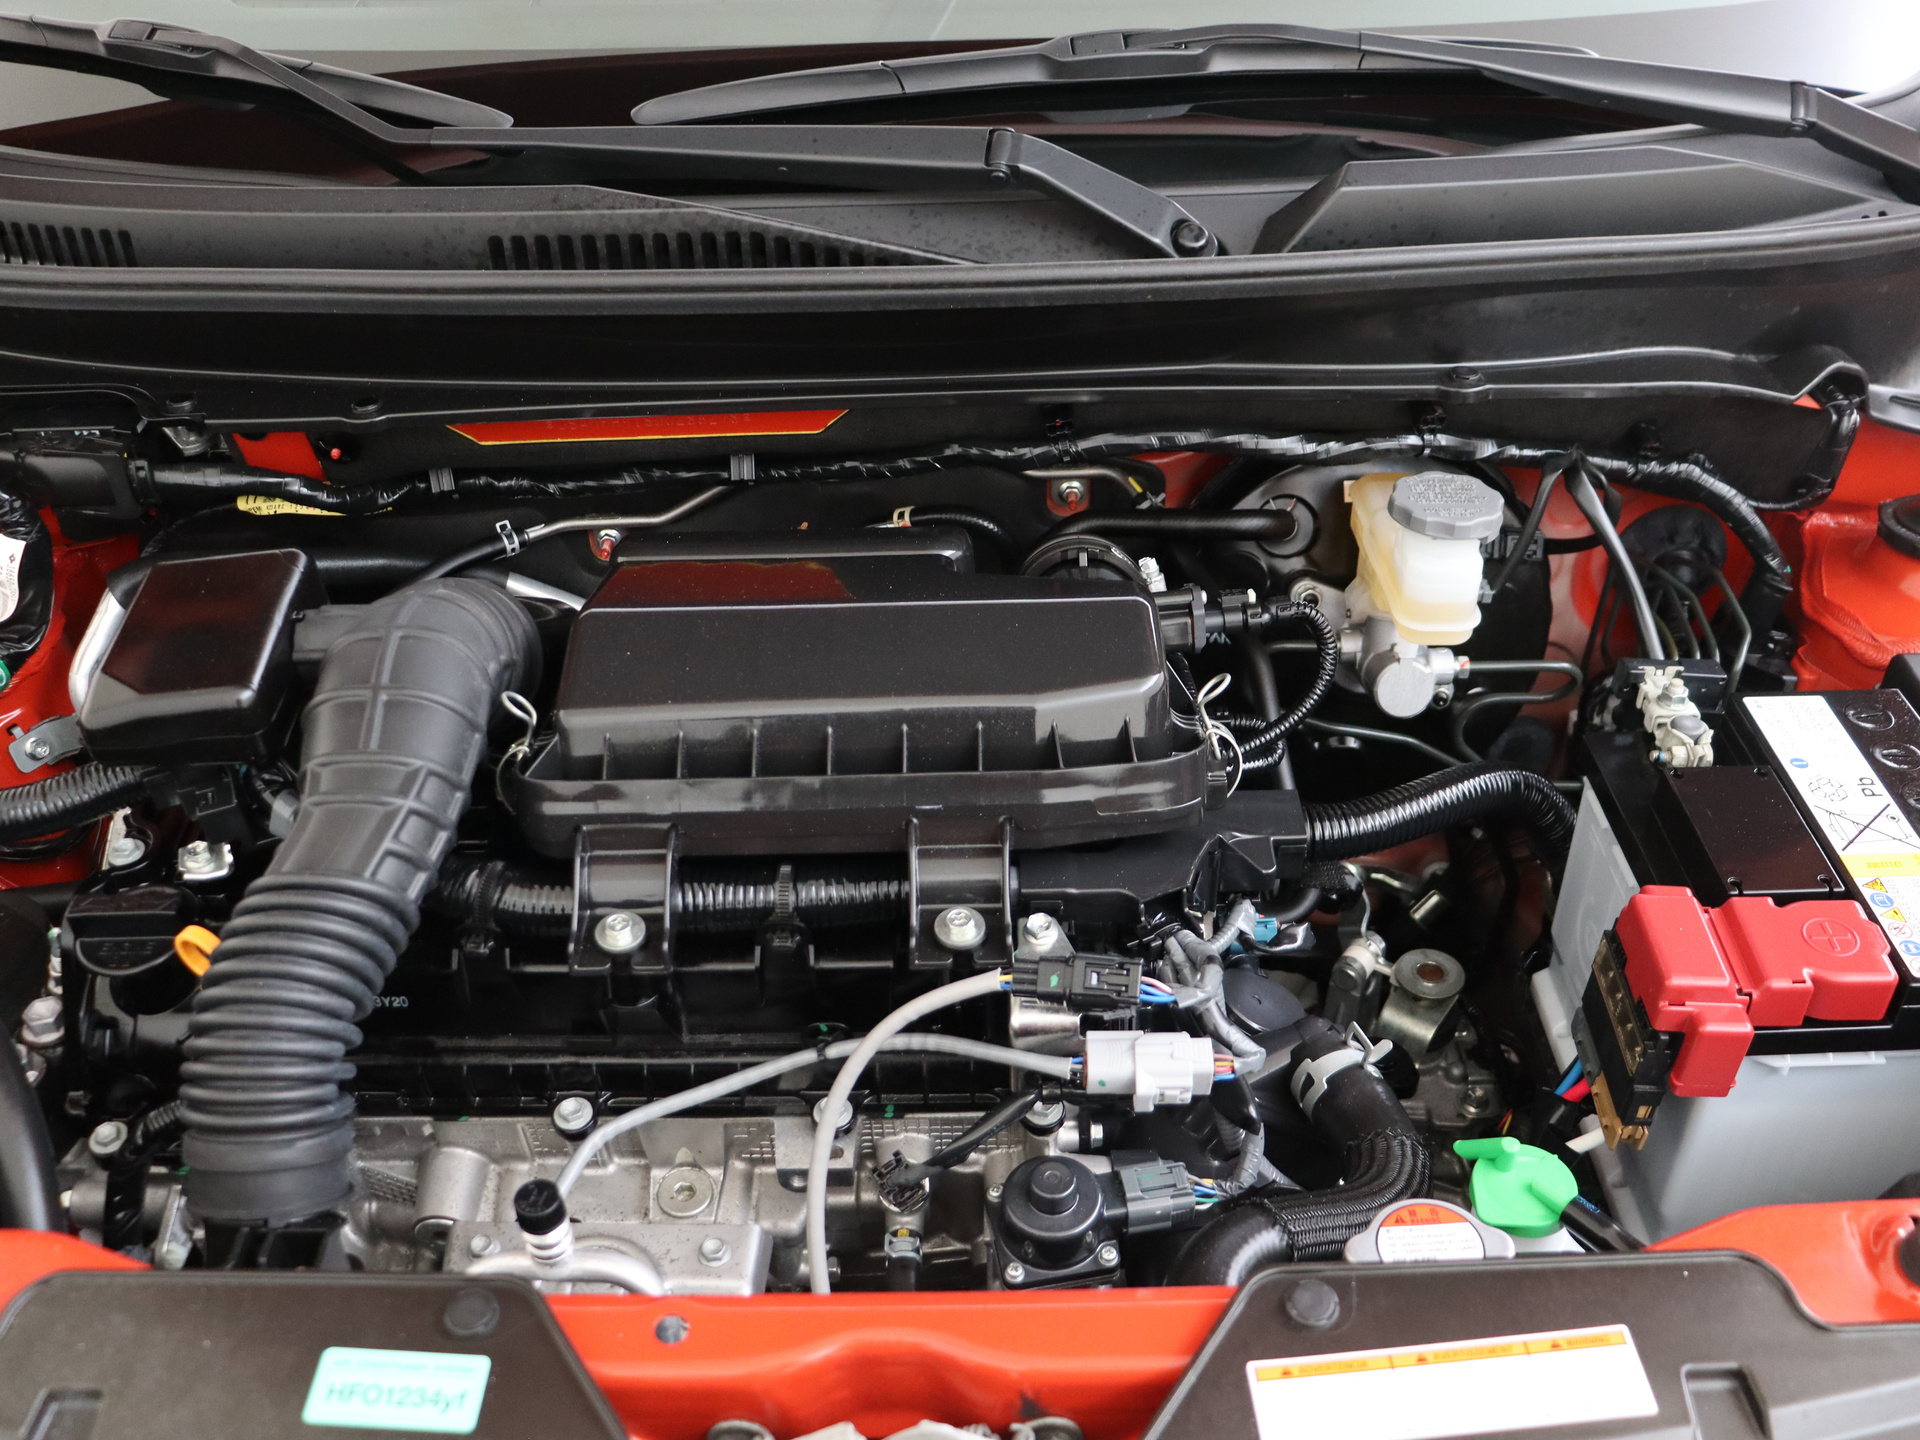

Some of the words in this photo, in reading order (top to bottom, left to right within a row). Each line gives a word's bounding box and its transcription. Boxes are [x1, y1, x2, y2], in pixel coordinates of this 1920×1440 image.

[1856, 776, 1884, 798] Pb
[1410, 1216, 1442, 1224] WARNING
[1298, 1359, 1369, 1375] ADVERTENCIA
[1432, 1343, 1513, 1362] AVERTISSEMENT
[1565, 1334, 1611, 1348] WARNING
[326, 1382, 468, 1414] HFO1234yf
